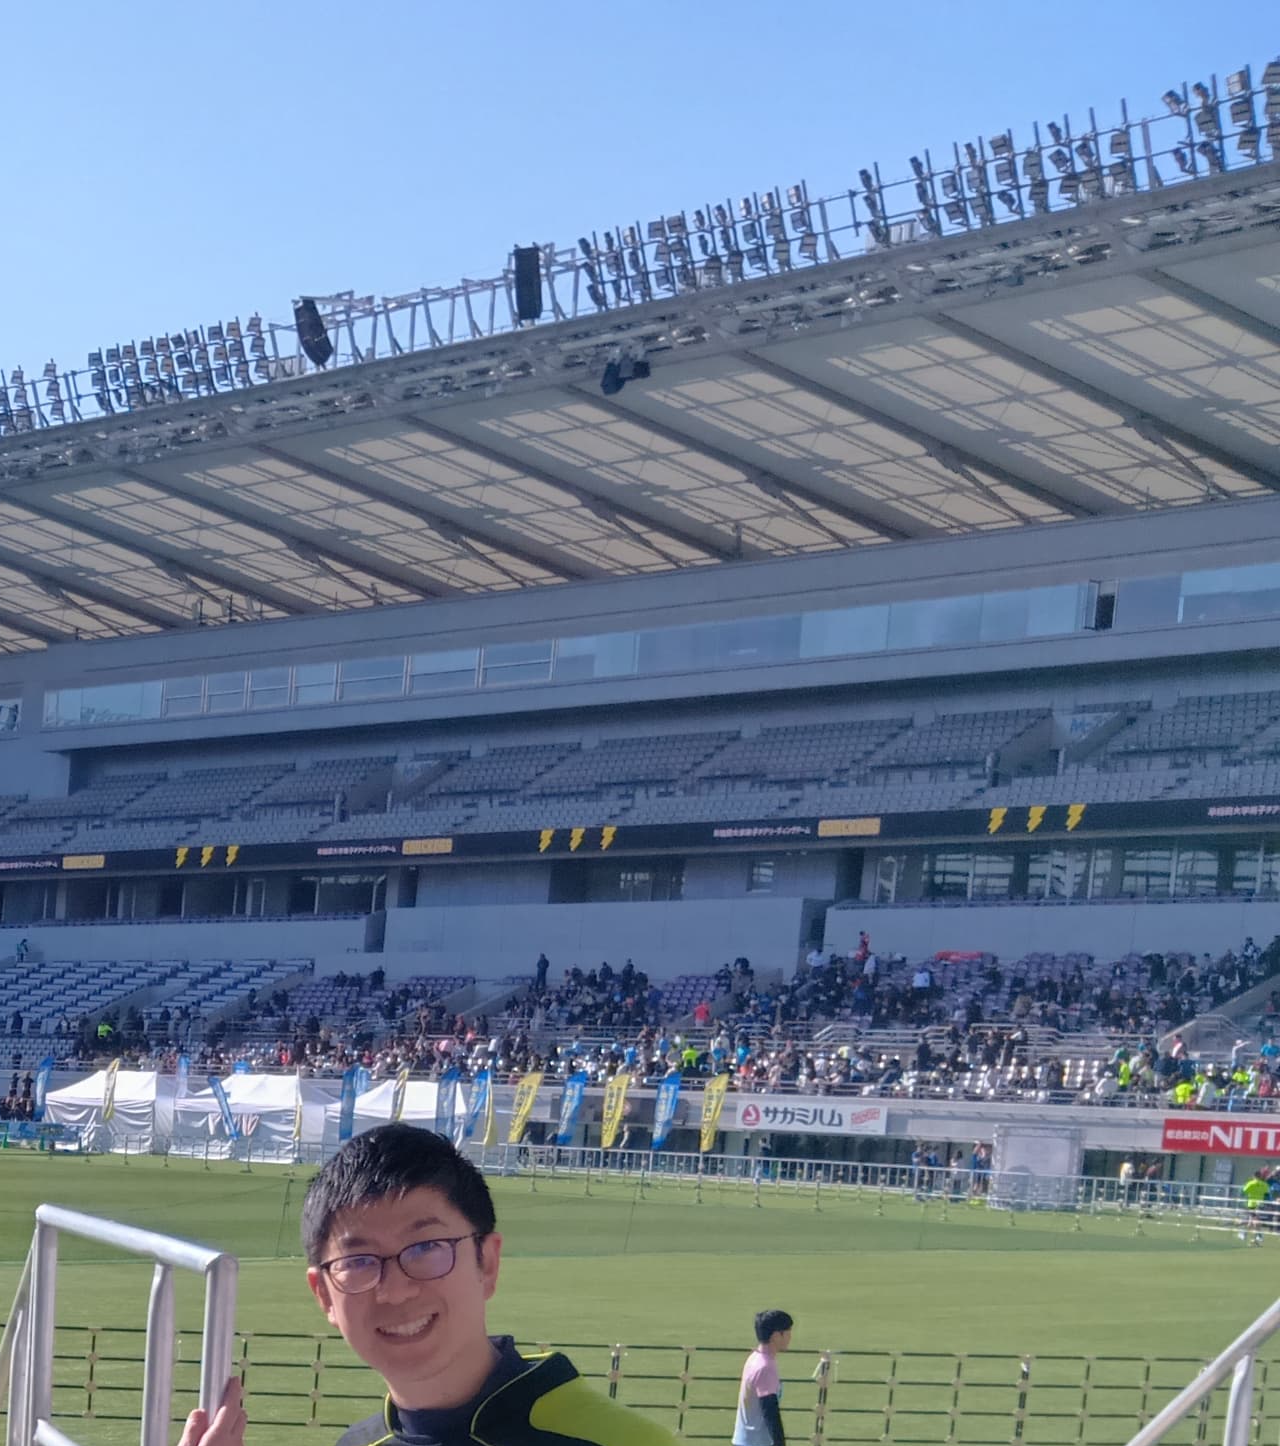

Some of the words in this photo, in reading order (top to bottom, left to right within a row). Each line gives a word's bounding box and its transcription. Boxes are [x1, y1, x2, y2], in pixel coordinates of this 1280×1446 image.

[763, 1106, 843, 1127] サガミハム
[1208, 1125, 1280, 1151] NITT
